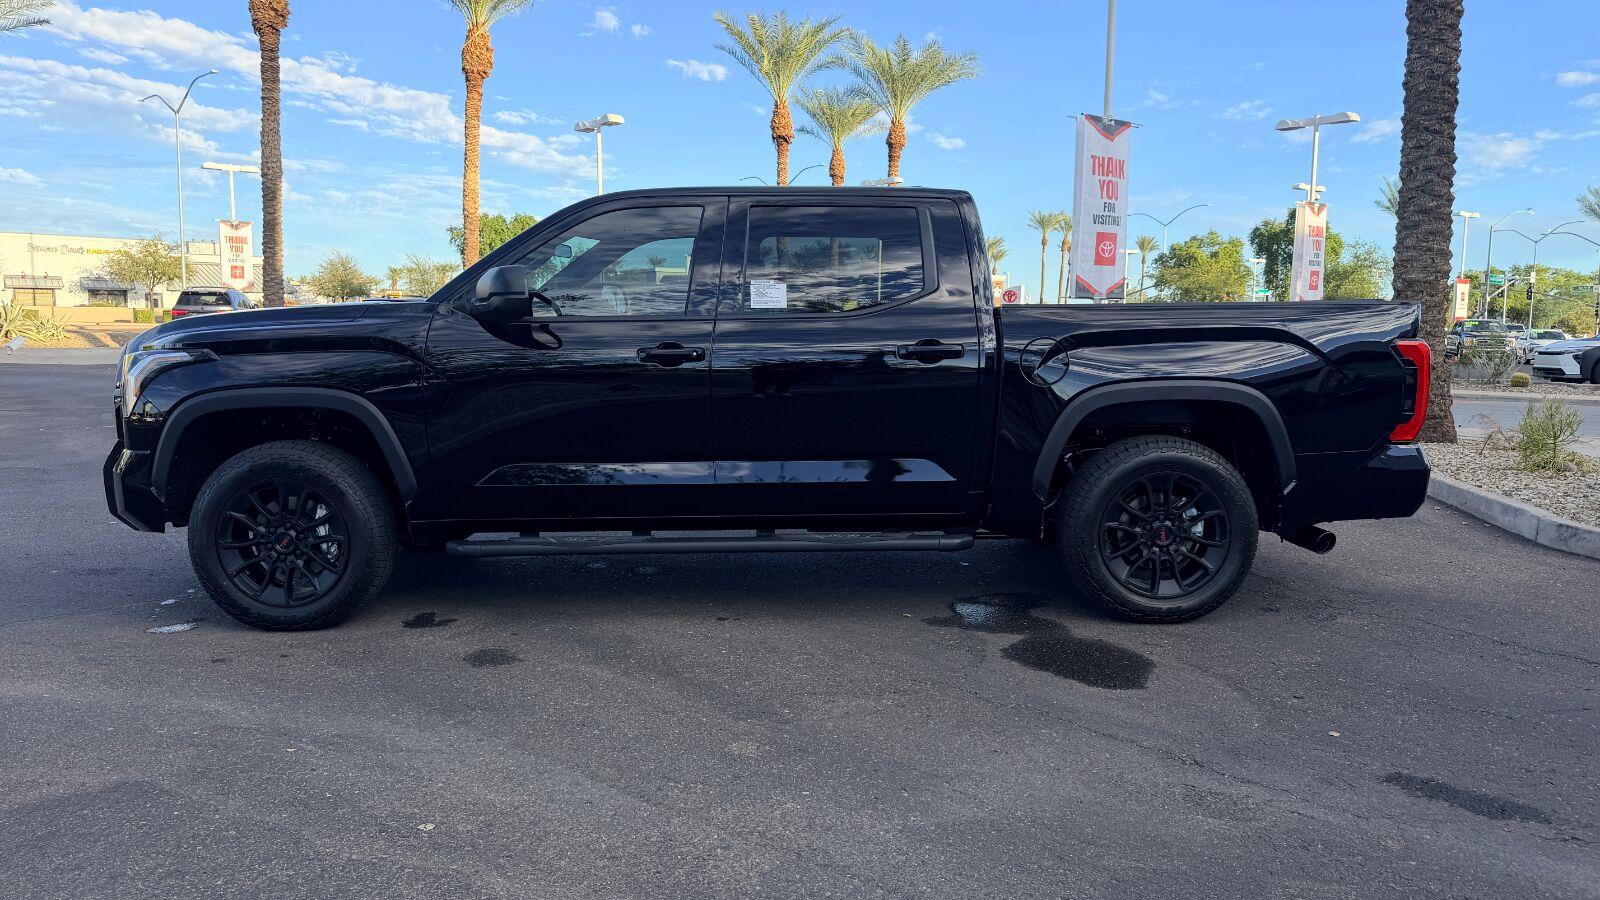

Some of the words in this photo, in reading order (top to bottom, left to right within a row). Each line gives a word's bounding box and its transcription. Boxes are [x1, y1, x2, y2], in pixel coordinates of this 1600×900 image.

[1091, 155, 1125, 179] THANK
[1098, 179, 1119, 200] YOU
[1103, 202, 1116, 214] FOR
[224, 236, 248, 245] THANK
[229, 244, 244, 253] YOU
